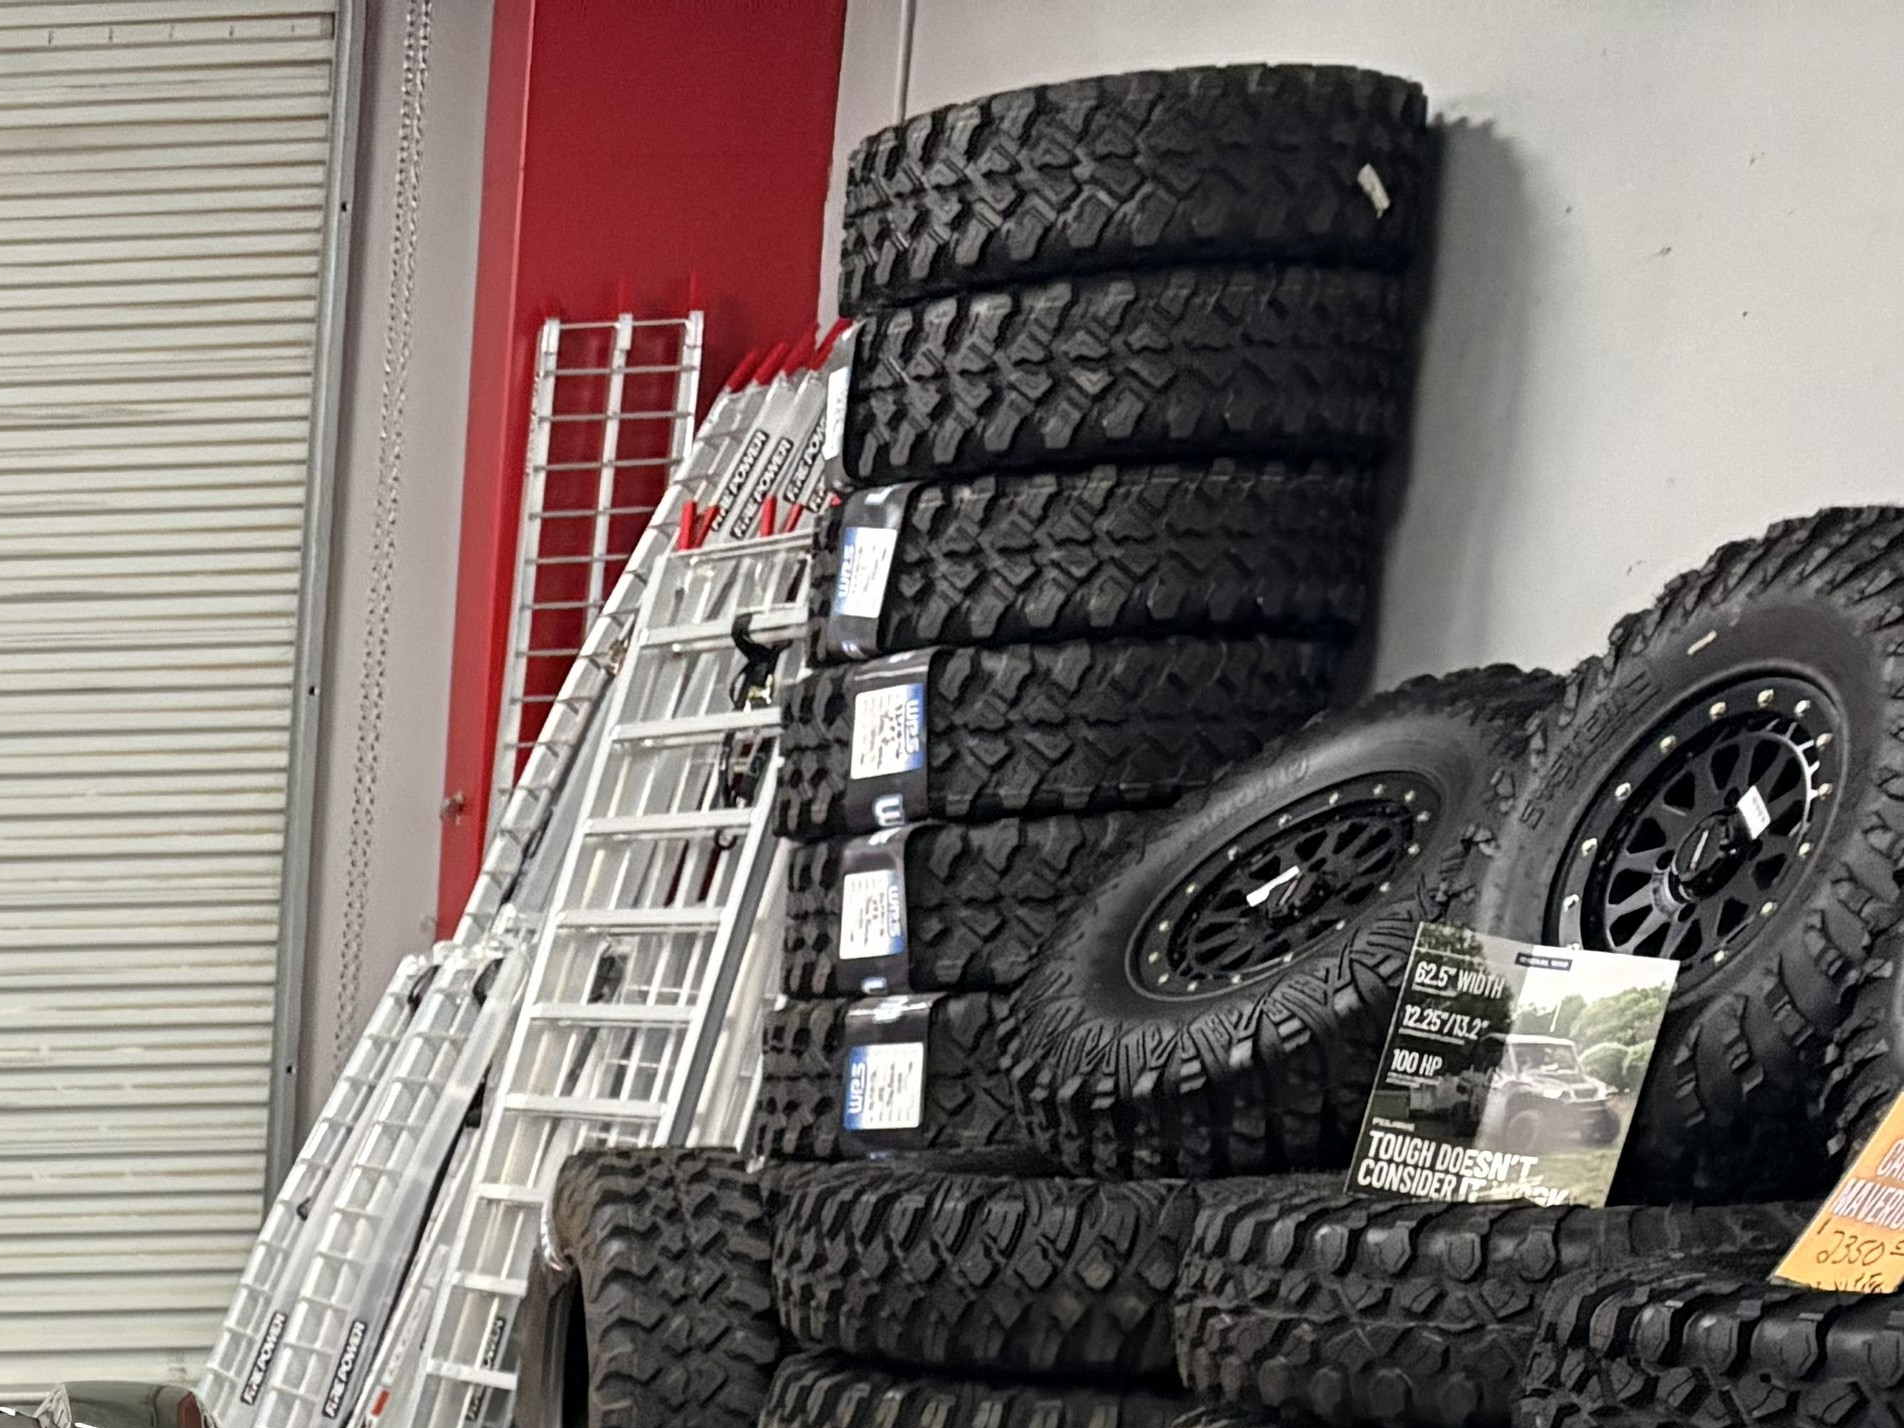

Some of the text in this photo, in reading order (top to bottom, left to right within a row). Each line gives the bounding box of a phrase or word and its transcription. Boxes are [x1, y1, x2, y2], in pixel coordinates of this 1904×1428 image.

[1414, 960, 1505, 999] 62.5" WIDTH
[1391, 1048, 1443, 1077] 100 HP
[1368, 1130, 1538, 1183] TOUGH DOESN'T
[1357, 1158, 1457, 1201] CONSIDER
